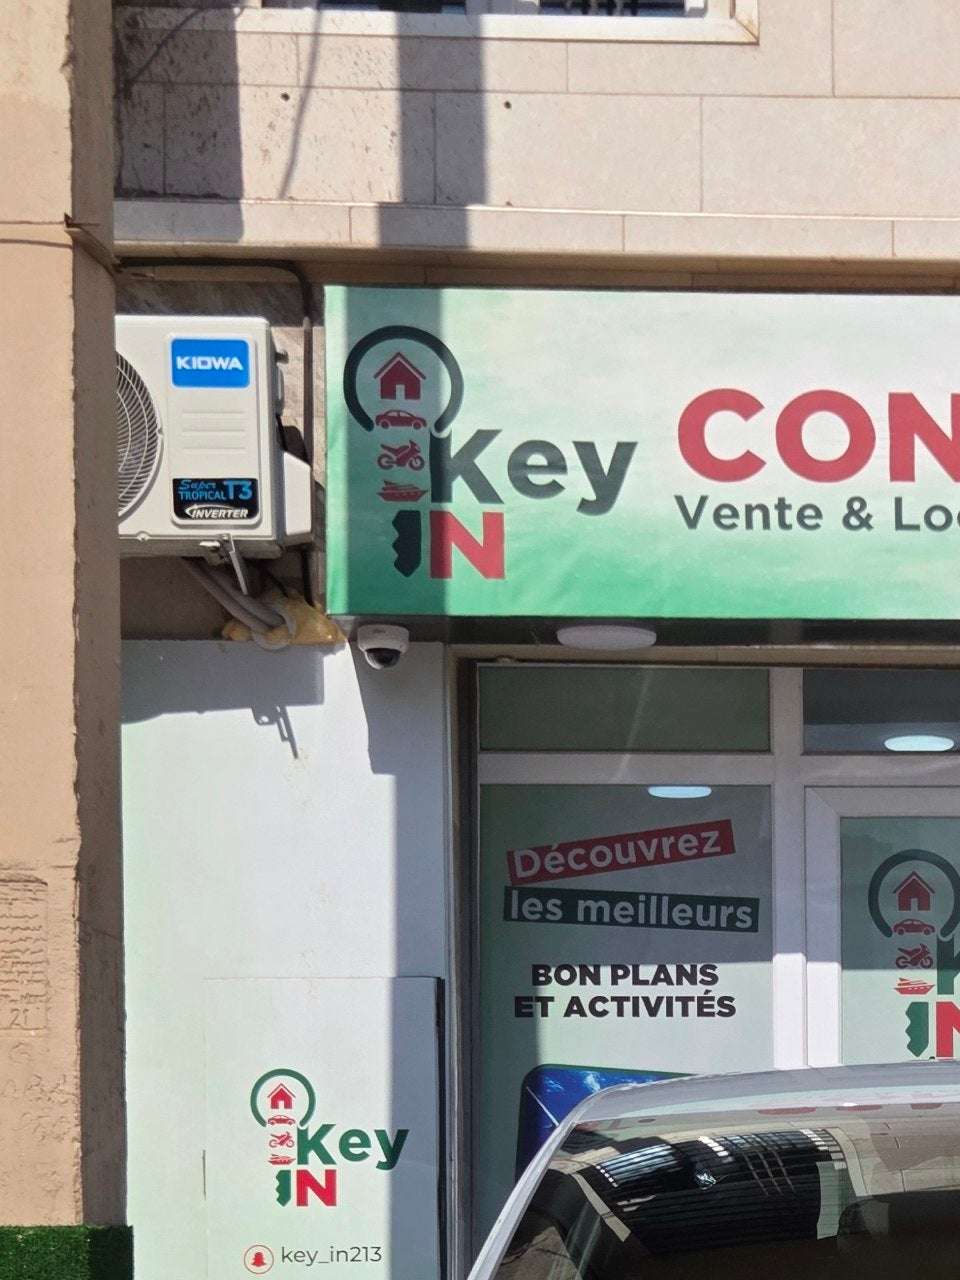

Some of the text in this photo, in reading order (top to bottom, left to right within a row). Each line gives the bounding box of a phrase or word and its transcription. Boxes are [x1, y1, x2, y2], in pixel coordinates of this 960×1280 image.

[176, 356, 244, 370] KIOWA
[429, 428, 638, 516] Key
[178, 491, 227, 500] TROPICAL
[223, 480, 253, 500] T3
[191, 508, 249, 519] INVERTER
[674, 494, 824, 531] Vente
[842, 496, 875, 531] &
[513, 830, 721, 879] Découvrez
[510, 889, 753, 929] les meilleurs
[531, 963, 719, 987] BON PLANS
[514, 989, 737, 1018] ET ACTIVITÉS
[297, 1124, 410, 1170] Key
[281, 1246, 383, 1267] key_in213
